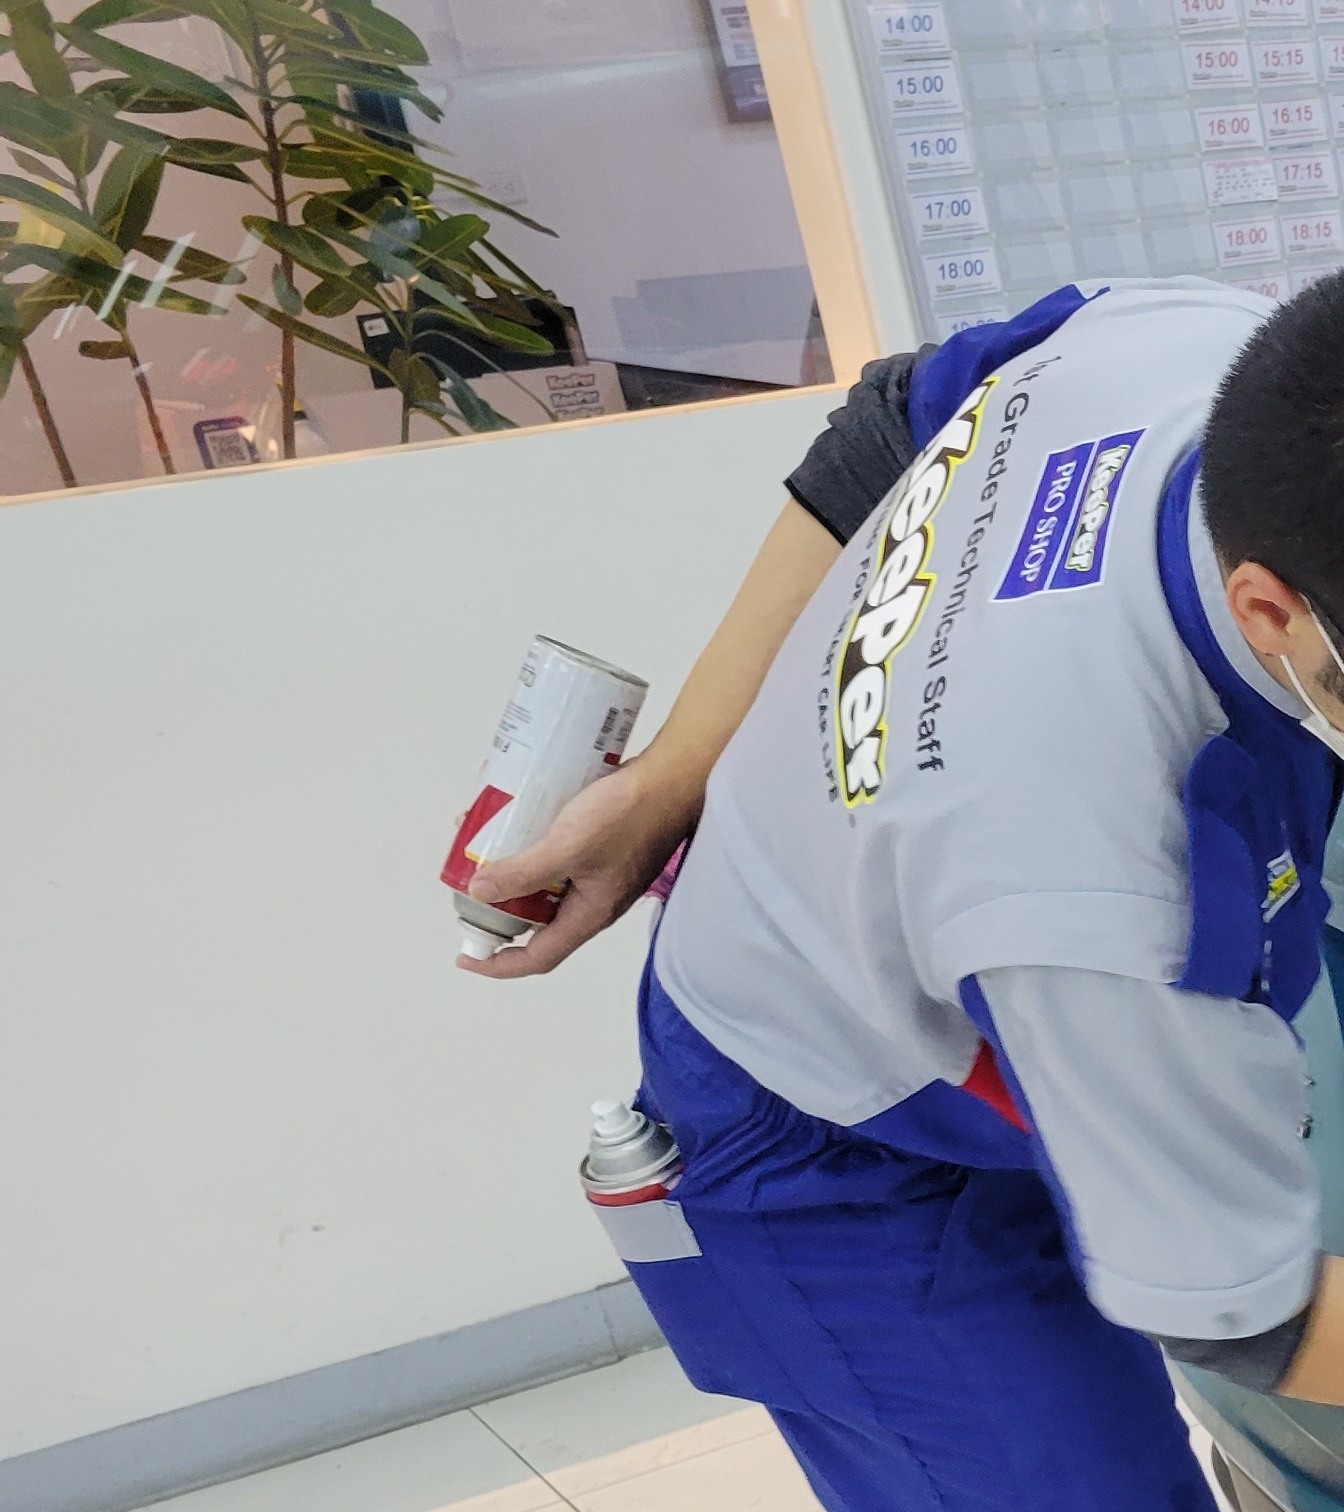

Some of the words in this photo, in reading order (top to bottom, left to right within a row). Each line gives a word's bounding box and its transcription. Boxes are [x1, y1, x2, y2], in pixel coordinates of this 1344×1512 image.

[885, 14, 934, 35] 14:00
[1195, 51, 1238, 68] 15:00
[1262, 49, 1304, 67] 15:15
[896, 75, 944, 95] 15:00
[1272, 105, 1313, 124] 16:15
[1208, 117, 1250, 136] 16:00
[910, 137, 957, 157] 16:00
[1283, 163, 1323, 181] 17:15
[925, 199, 971, 219] 17:00
[1226, 228, 1268, 247] 18:00
[1292, 221, 1332, 240] 18:15
[938, 259, 984, 280] 18:00
[981, 392, 1030, 502] Grade
[1043, 460, 1078, 513] PRO
[1064, 444, 1132, 572] KeePer
[1020, 517, 1058, 583] SHOP
[835, 375, 1001, 809] KeePer
[926, 501, 998, 670] Technical
[916, 676, 947, 772] Staff
